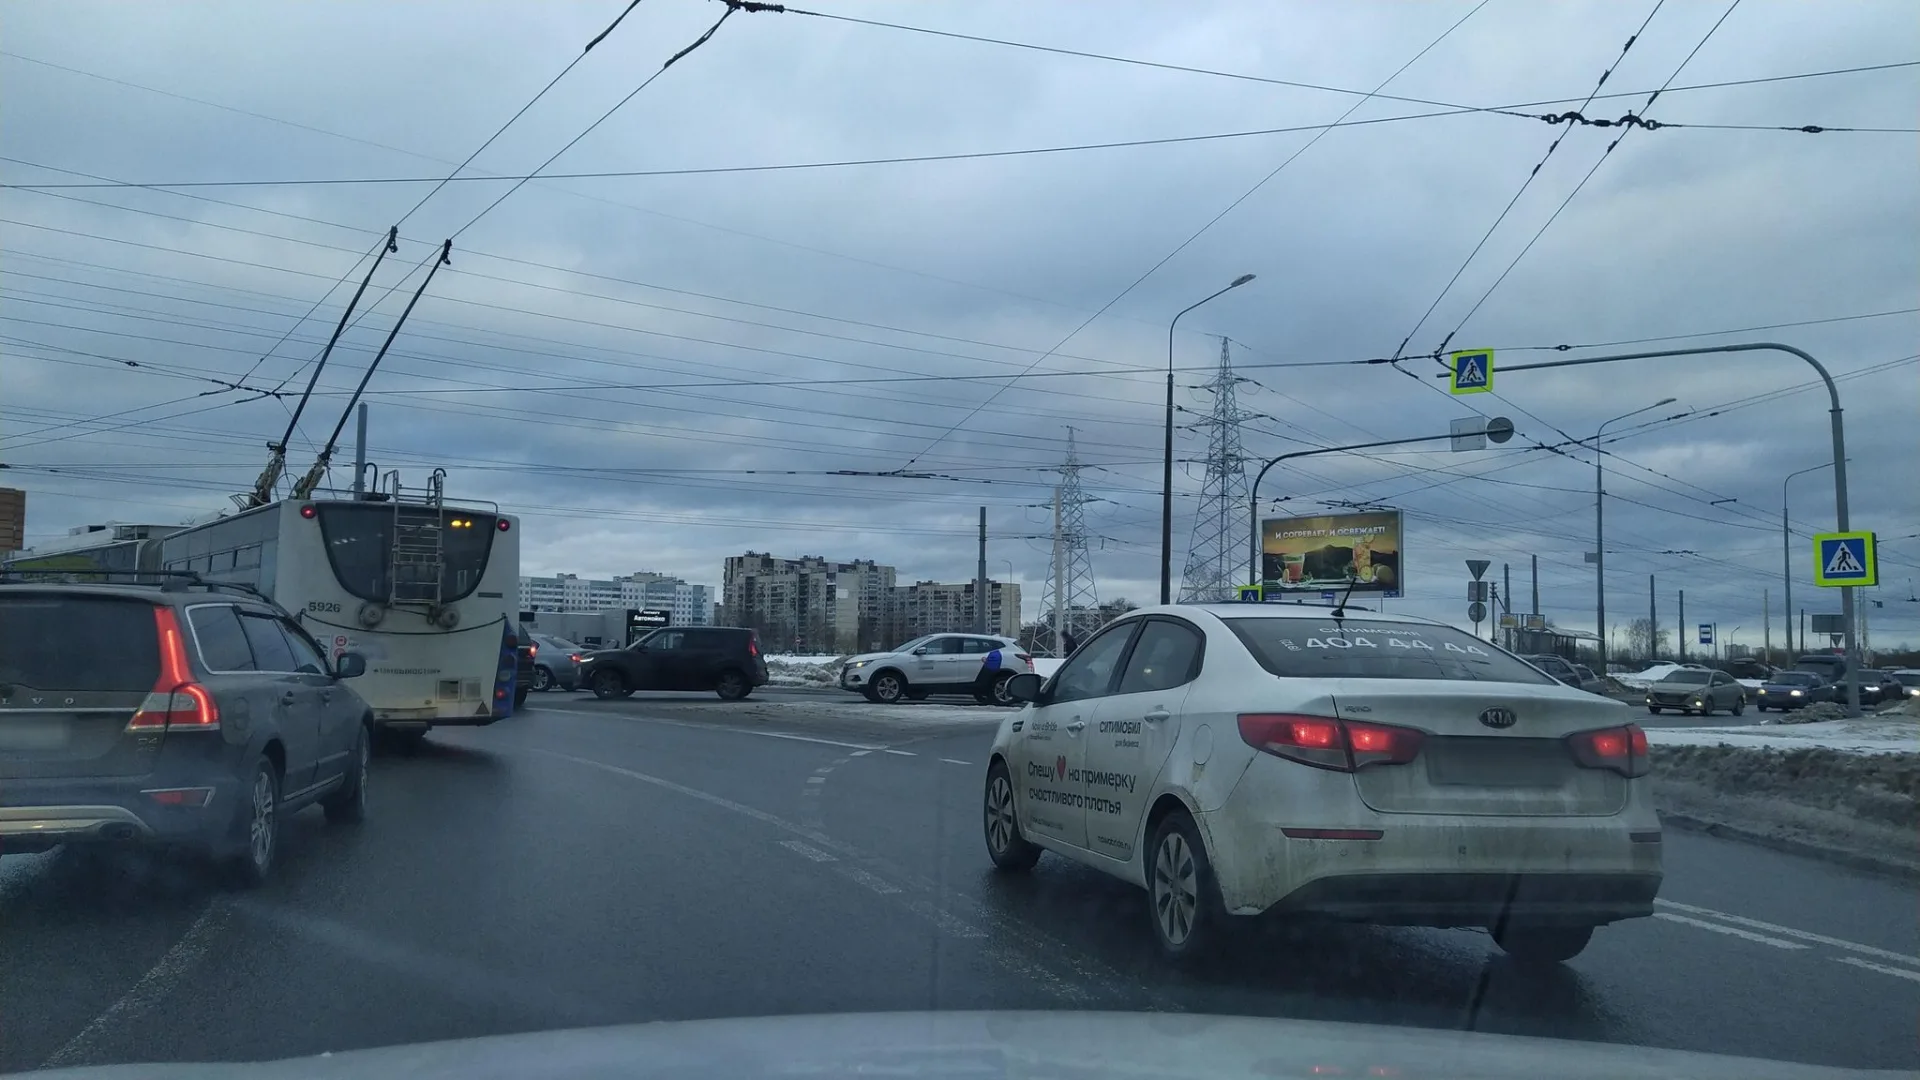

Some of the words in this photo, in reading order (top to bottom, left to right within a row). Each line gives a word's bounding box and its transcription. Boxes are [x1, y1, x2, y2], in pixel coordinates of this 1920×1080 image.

[1275, 531, 1282, 540] И
[1329, 527, 1336, 537] И
[1337, 525, 1386, 537] ОСВЕЖАЕТ!
[308, 601, 341, 613] 5926
[1306, 636, 1379, 650] 404
[1388, 637, 1434, 651] 44
[1444, 641, 1490, 657] 44
[1486, 710, 1513, 724] KIA
[1100, 721, 1141, 734] СИТИМОБИЛ
[1028, 761, 1055, 782] Спешу
[1068, 769, 1080, 780] на
[1081, 769, 1136, 793] примерку
[1029, 788, 1083, 808] счастливого
[1085, 796, 1121, 815] платья
